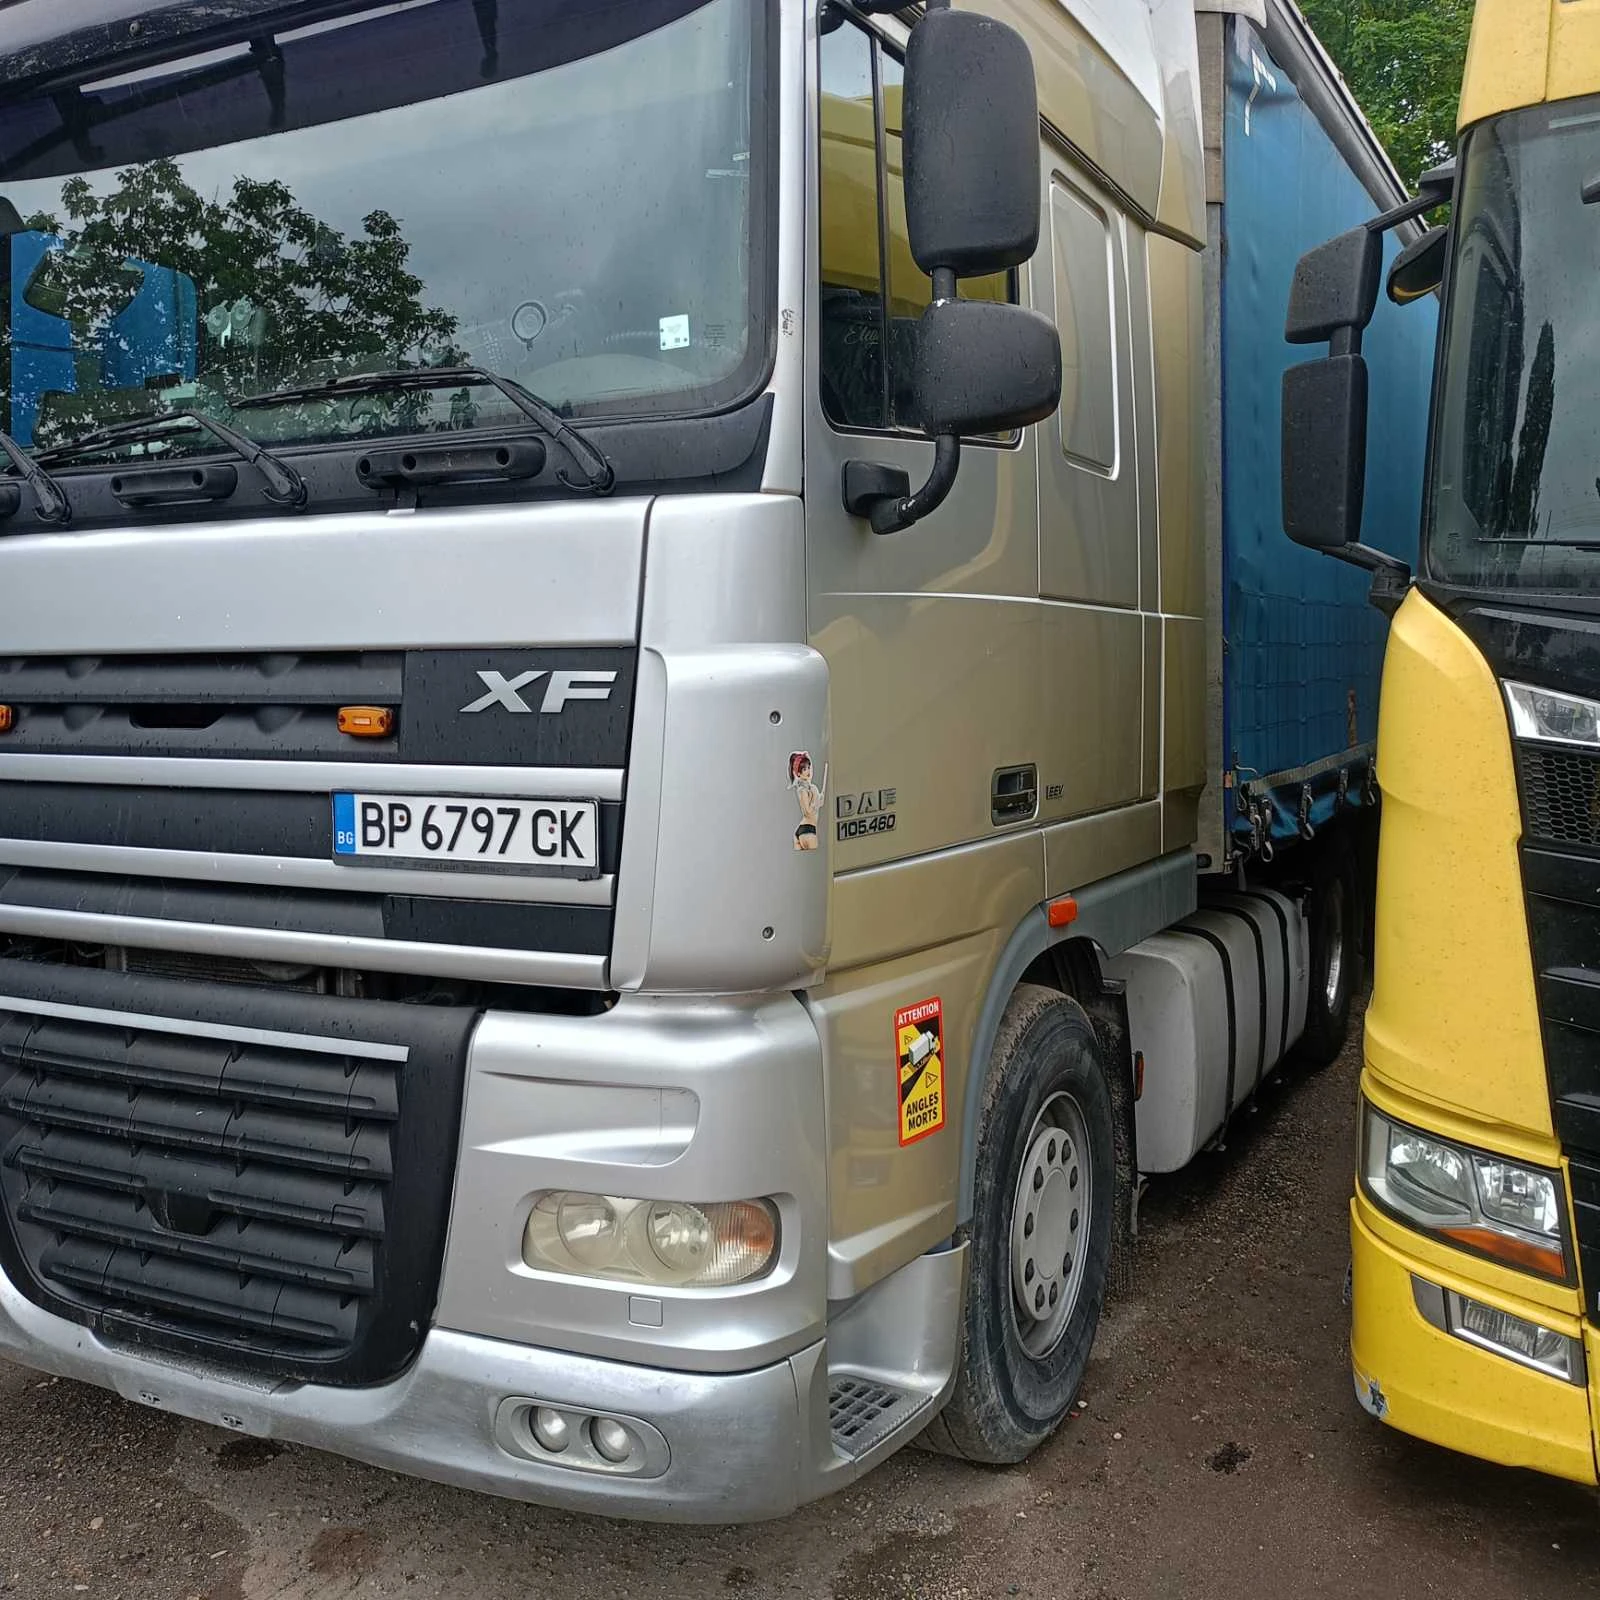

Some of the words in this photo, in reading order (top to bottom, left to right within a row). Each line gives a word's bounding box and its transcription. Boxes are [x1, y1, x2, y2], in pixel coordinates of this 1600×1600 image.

[459, 671, 618, 713] XF
[837, 788, 896, 818] DAF
[338, 831, 353, 845] BG
[361, 801, 411, 848] BP
[421, 804, 520, 854] 6797
[532, 808, 585, 858] CK
[841, 814, 896, 838] 105.460
[898, 1001, 939, 1025] ATTENTION
[906, 1092, 939, 1117] ANGLES
[908, 1107, 938, 1131] MORTS
